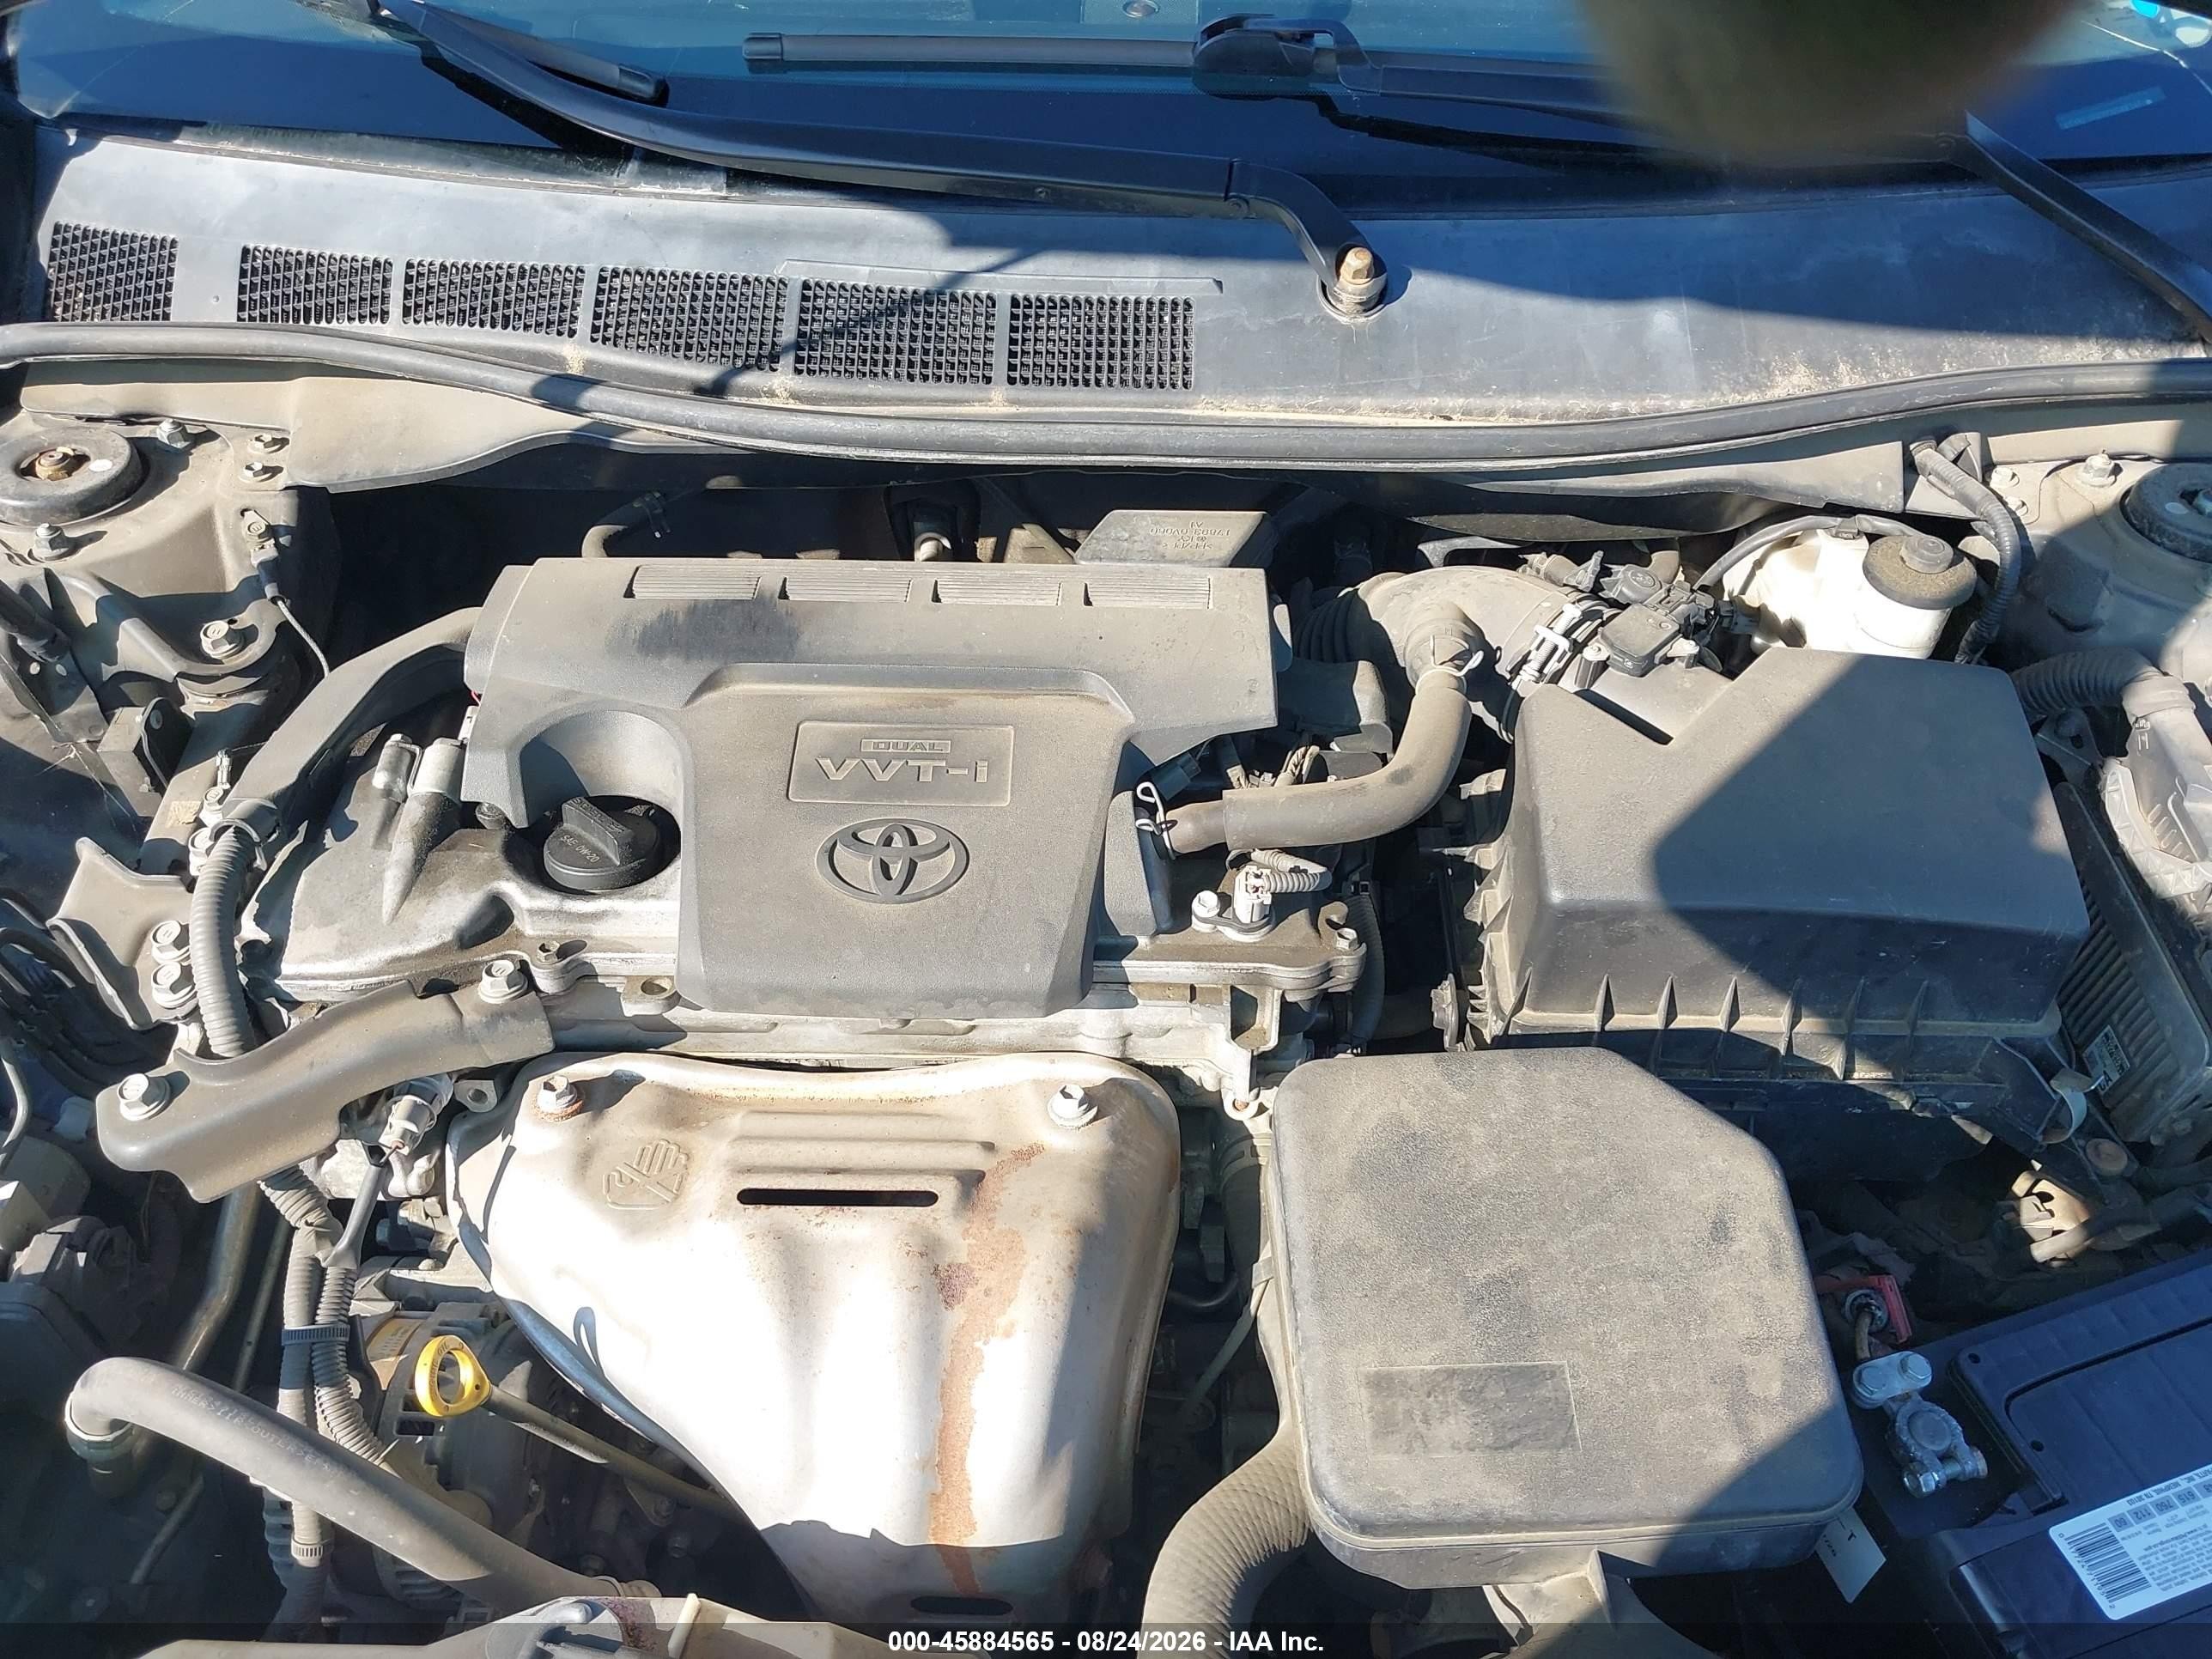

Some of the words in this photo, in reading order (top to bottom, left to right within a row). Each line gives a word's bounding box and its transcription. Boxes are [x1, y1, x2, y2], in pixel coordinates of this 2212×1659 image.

[872, 740, 943, 751] DUAL
[815, 756, 988, 783] VVT-i
[561, 835, 578, 846] SAE
[575, 846, 600, 862] 0W-20
[2176, 1490, 2196, 1504] 615
[2133, 1506, 2152, 1522] 112
[2154, 1498, 2172, 1514] 760
